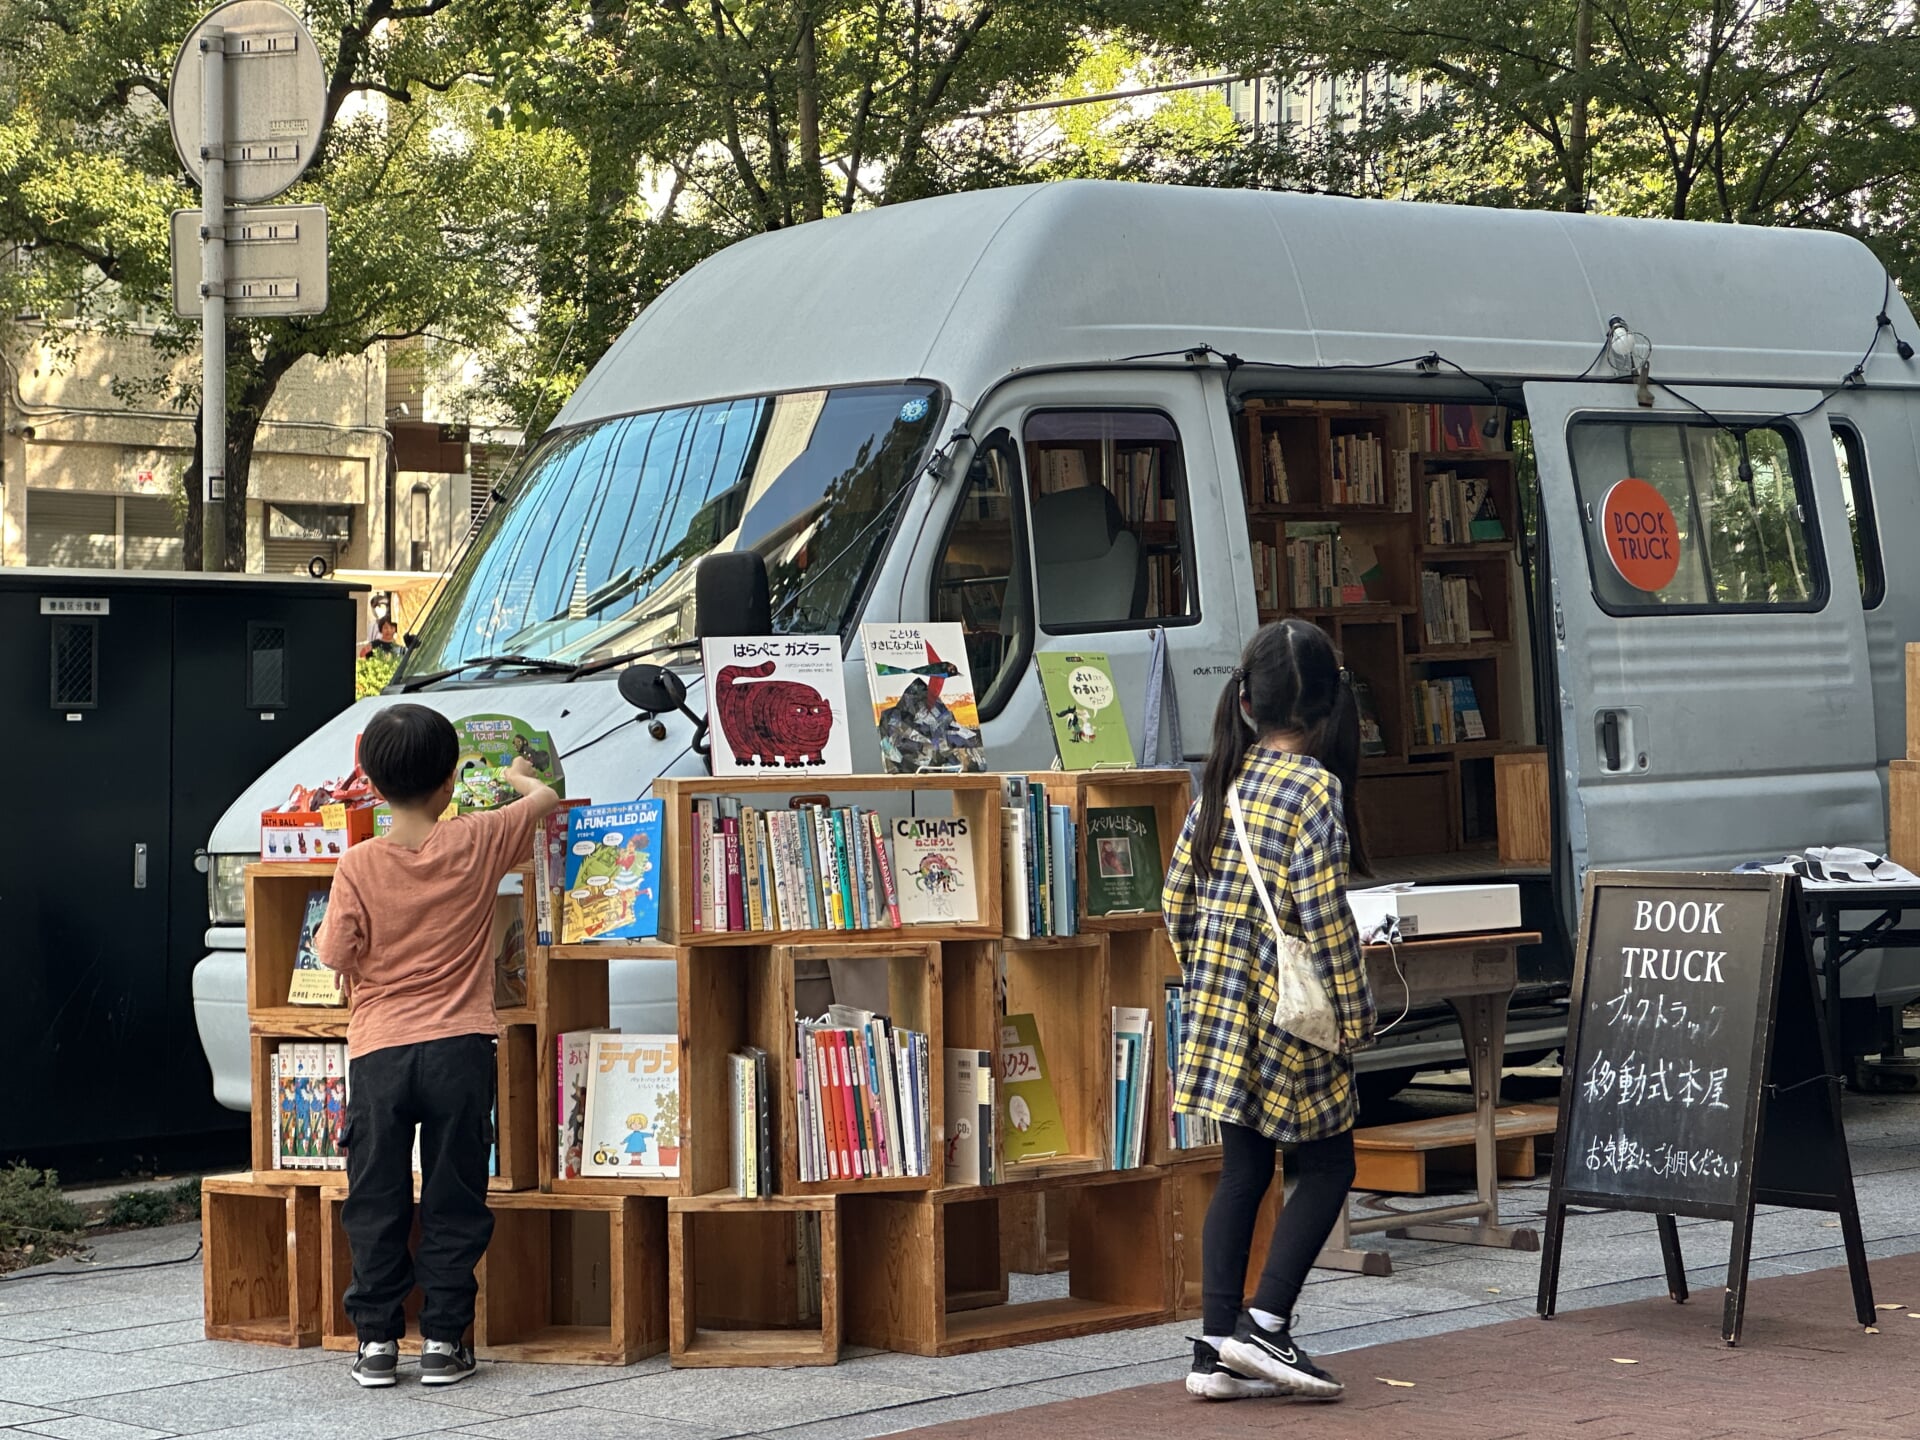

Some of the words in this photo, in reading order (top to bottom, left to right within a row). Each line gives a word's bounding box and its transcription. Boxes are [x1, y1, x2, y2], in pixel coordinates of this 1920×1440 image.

[1614, 511, 1668, 535] BOOK
[1618, 537, 1672, 560] TRUCK
[889, 629, 921, 639] ことりを
[734, 642, 780, 658] はらぺこ
[785, 642, 831, 656] ガズラー
[870, 640, 923, 650] すきになった山
[467, 721, 511, 732] 水てっぽう
[279, 818, 298, 827] BALL
[575, 818, 583, 830] A
[584, 812, 638, 830] FUN-FILLED
[639, 810, 658, 824] DAY
[915, 838, 954, 847] ねこぼうし
[1633, 900, 1725, 935] BOOK
[1621, 946, 1728, 984] TRUCK
[1606, 987, 1726, 1040] ブックトラック
[599, 1042, 678, 1073] ティッチ
[1582, 1049, 1730, 1109] 移動式本屋
